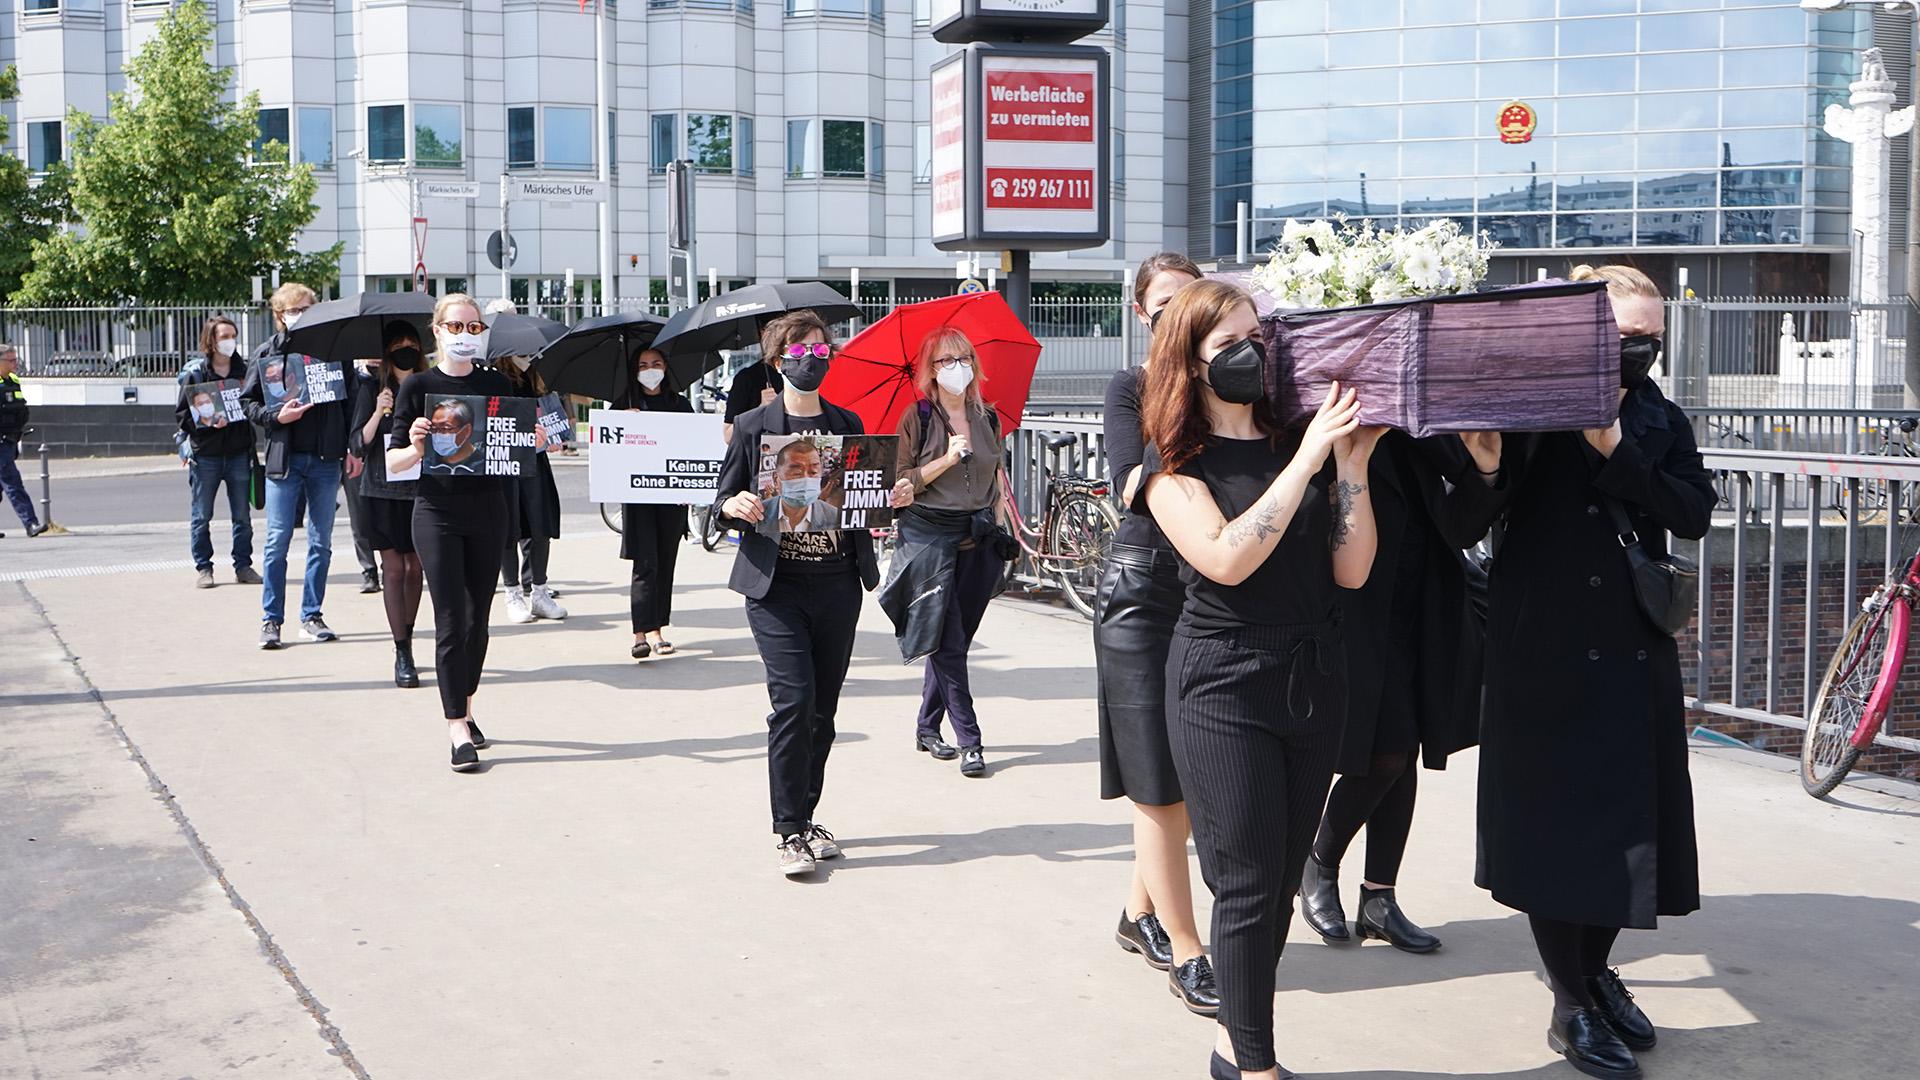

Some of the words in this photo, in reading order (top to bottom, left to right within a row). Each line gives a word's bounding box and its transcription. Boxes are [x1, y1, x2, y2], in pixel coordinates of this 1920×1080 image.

[990, 86, 1086, 103] Werbefläche
[990, 113, 1009, 125] zu
[1012, 110, 1090, 127] vermieten
[428, 186, 460, 194] Märkisches
[523, 184, 572, 195] Märkisches
[574, 184, 594, 195] Ufer
[1012, 178, 1037, 198] 259
[1040, 179, 1064, 198] 267
[1068, 179, 1090, 198] 111
[304, 363, 327, 375] FREE
[306, 370, 344, 384] CHEUNG
[224, 400, 242, 411] RYA
[487, 417, 516, 431] FREE
[538, 412, 560, 427] FREE
[486, 432, 536, 447] CHEUNG
[600, 427, 624, 444] RSF
[486, 447, 509, 460] KIM
[486, 461, 520, 475] HUNG
[668, 461, 705, 472] Keine
[709, 462, 722, 472] Fr
[633, 476, 666, 487] ohne
[669, 477, 718, 488] Pressef
[843, 470, 883, 489] FREE
[841, 489, 893, 509] JIMMY
[841, 510, 866, 528] LAI
[781, 540, 833, 555] BERNATION
